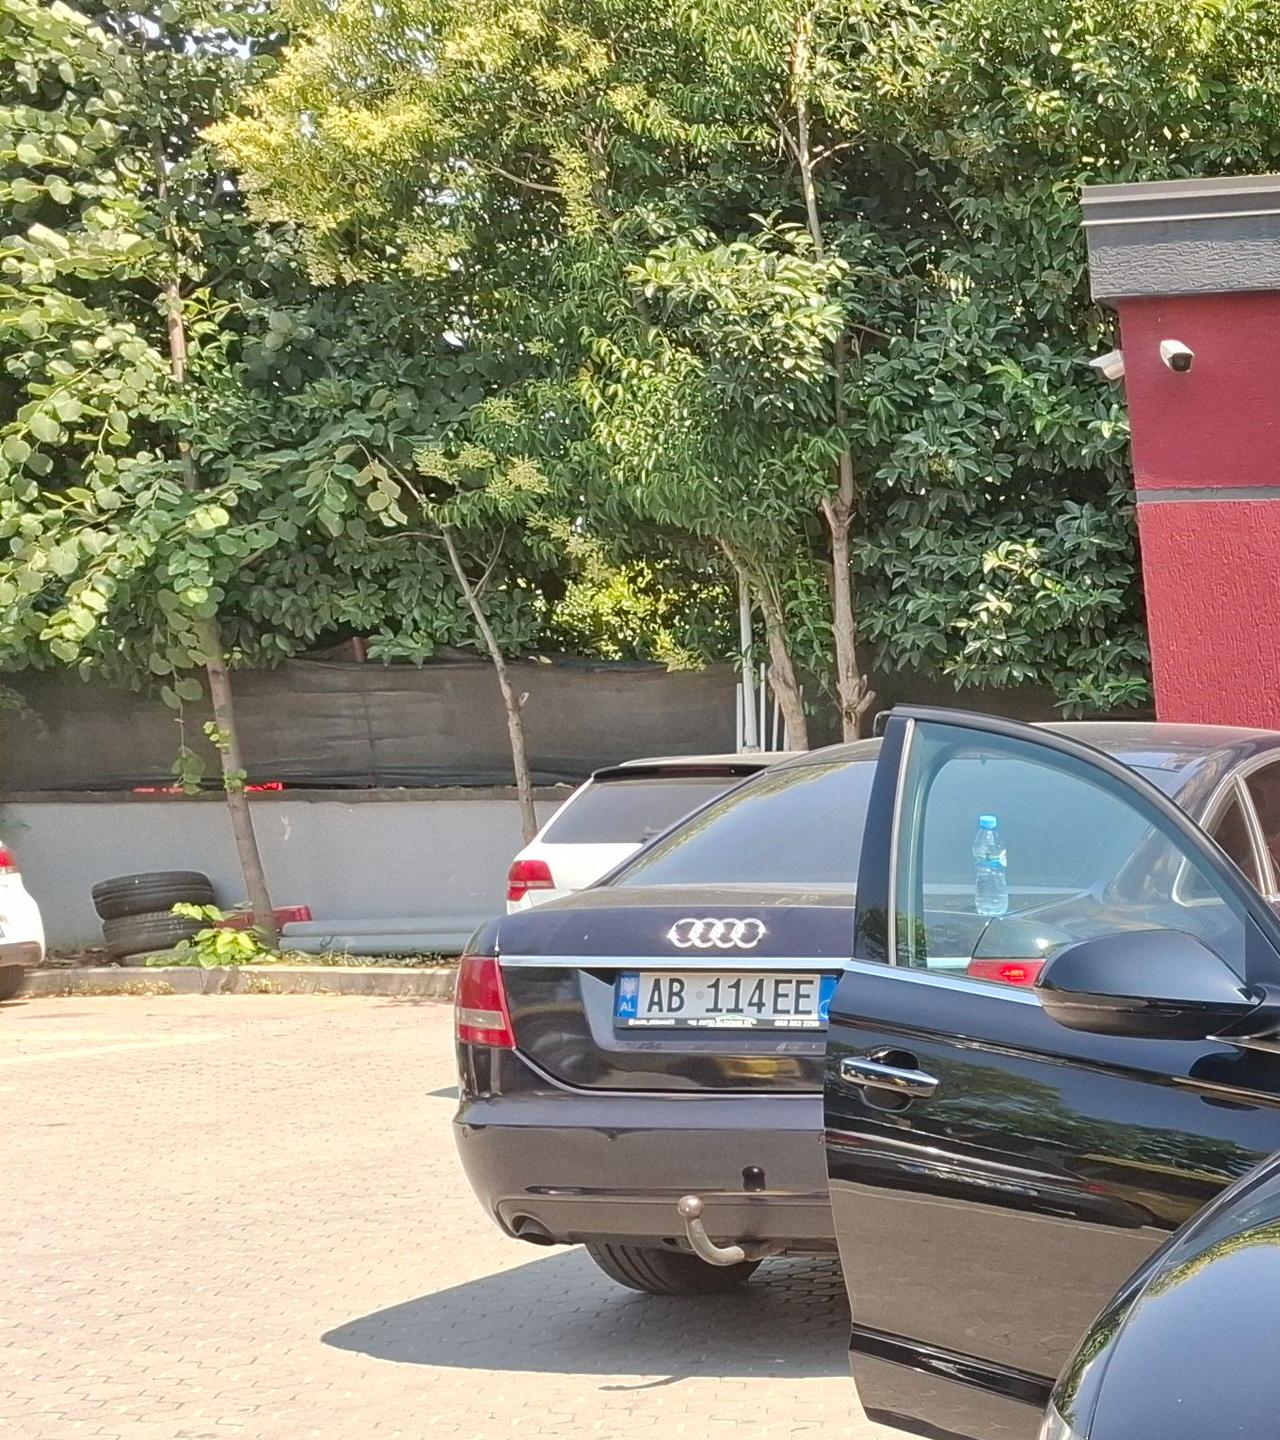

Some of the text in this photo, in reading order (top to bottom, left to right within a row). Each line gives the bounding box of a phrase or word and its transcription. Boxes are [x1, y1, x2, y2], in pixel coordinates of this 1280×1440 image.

[620, 1003, 636, 1012] AL
[646, 977, 814, 1015] AB 114EE
